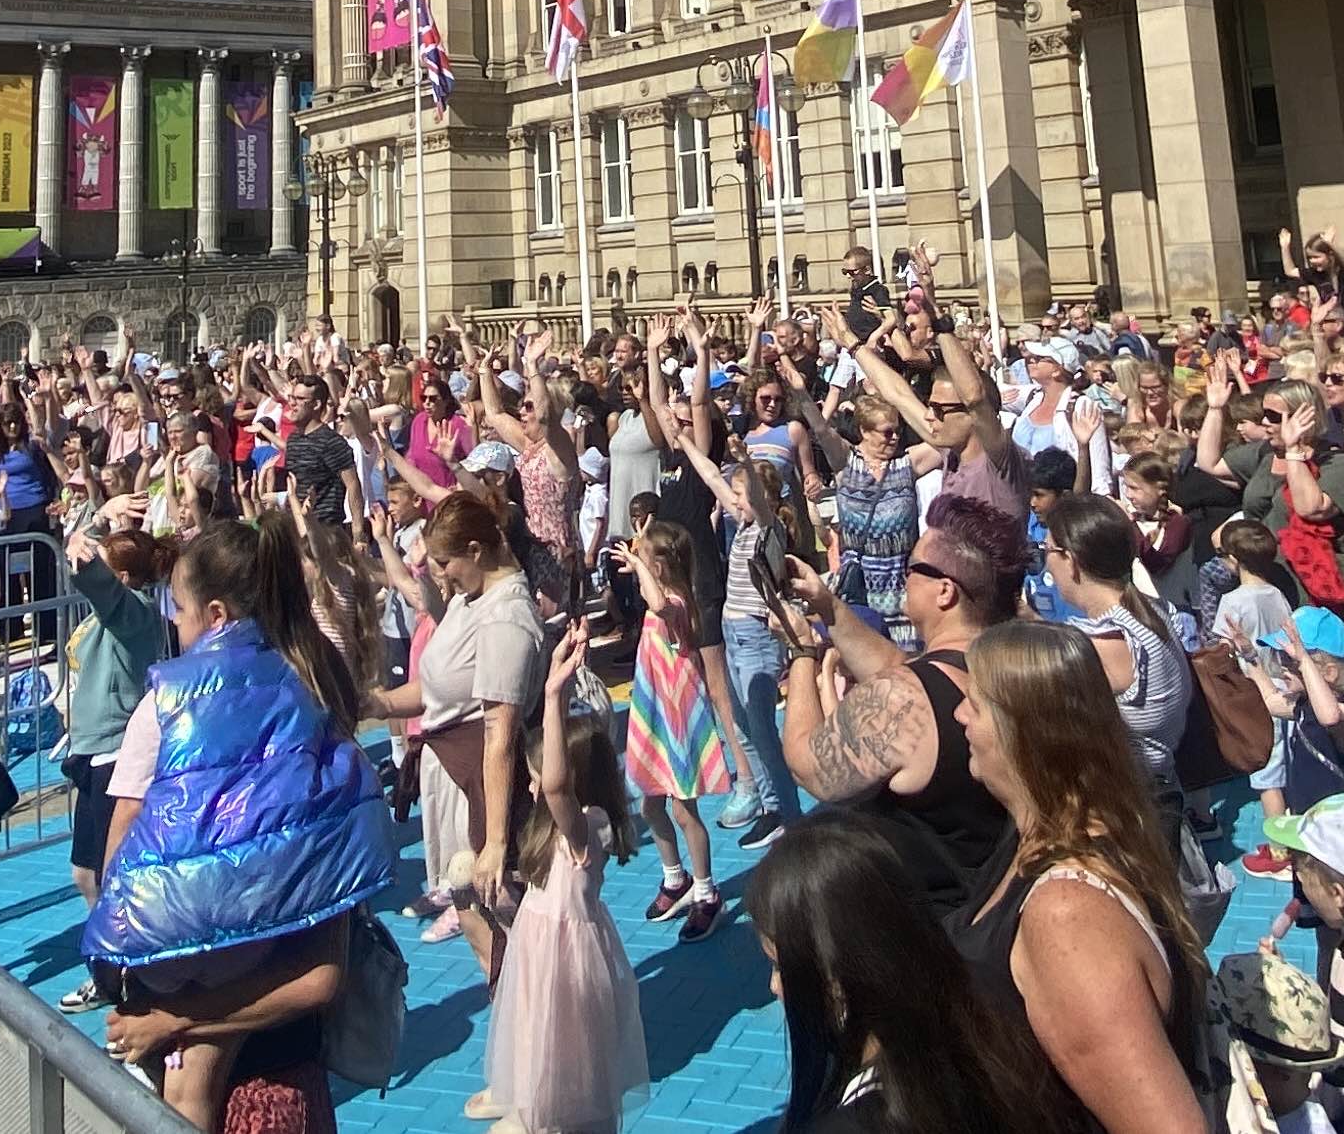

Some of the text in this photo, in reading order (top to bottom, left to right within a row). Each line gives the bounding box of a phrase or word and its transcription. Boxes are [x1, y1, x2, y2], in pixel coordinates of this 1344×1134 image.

[238, 139, 247, 157] just
[246, 134, 257, 200] the beginning
[238, 170, 246, 196] sport
